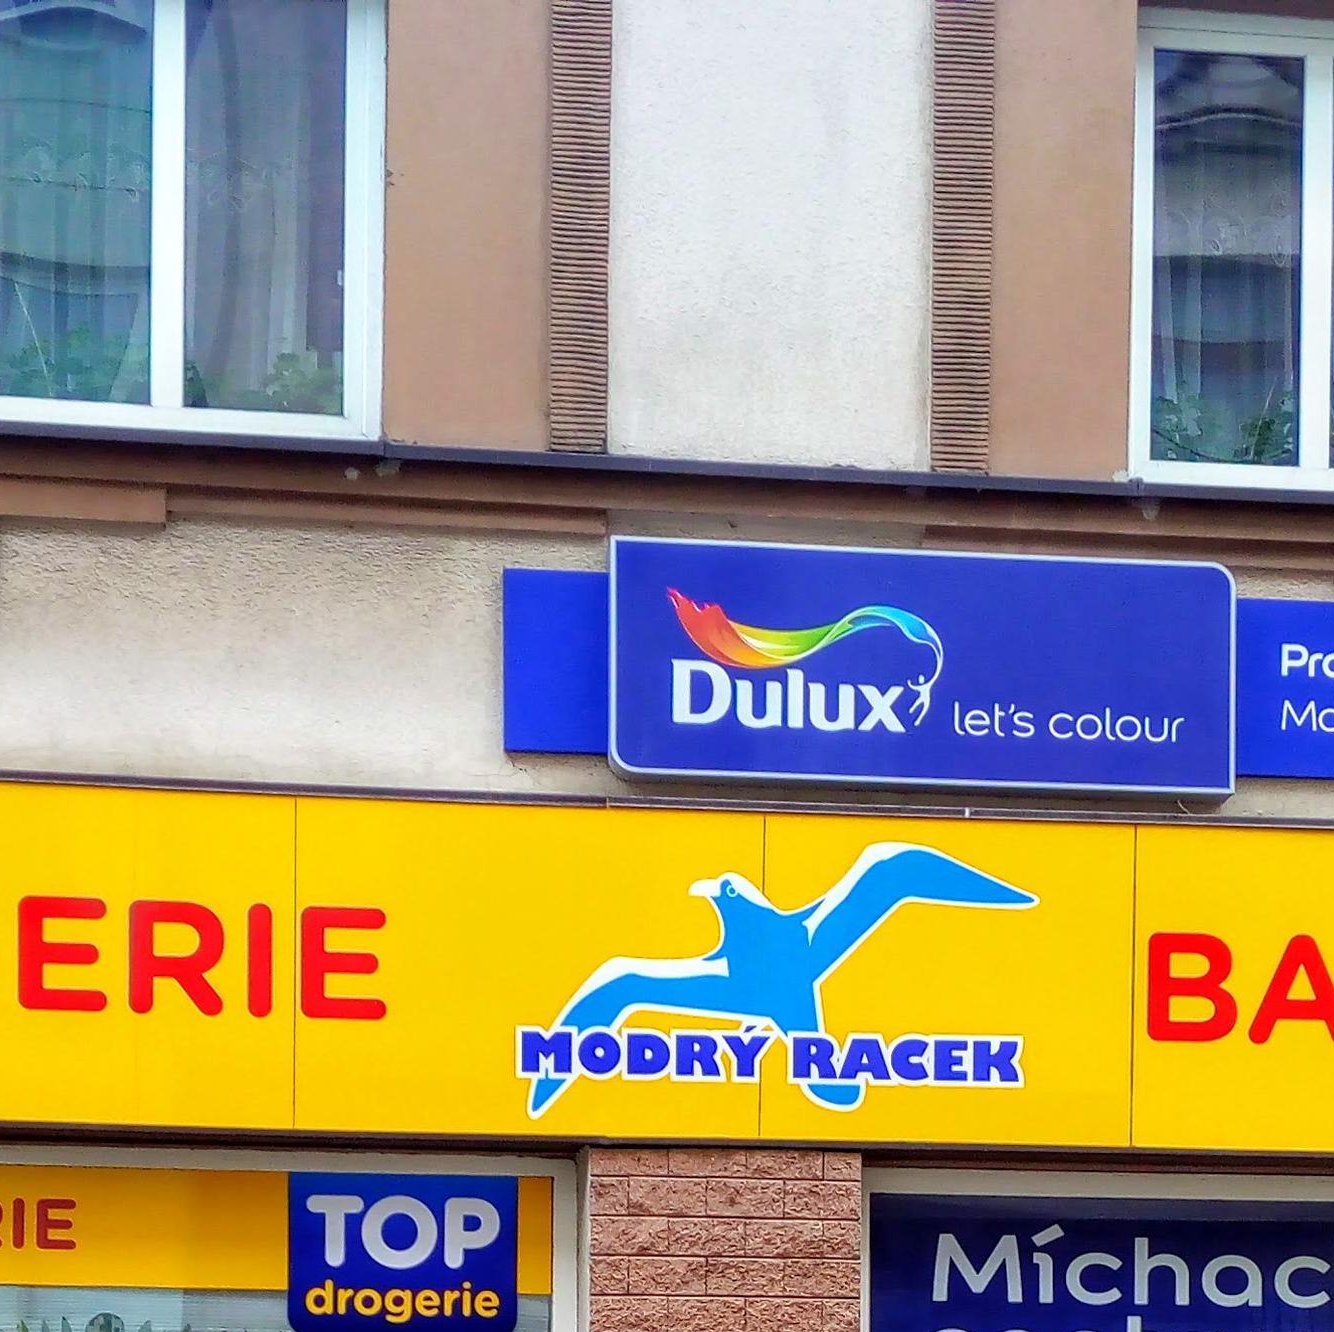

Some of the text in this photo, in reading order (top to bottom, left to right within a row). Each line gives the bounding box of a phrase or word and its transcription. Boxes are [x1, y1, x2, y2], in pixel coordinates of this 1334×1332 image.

[672, 658, 1185, 745] Dulux let's colour
[520, 1024, 1019, 1082] MODRÝ RACEK
[306, 1194, 501, 1270] TOP
[305, 1279, 500, 1325] drogerie
